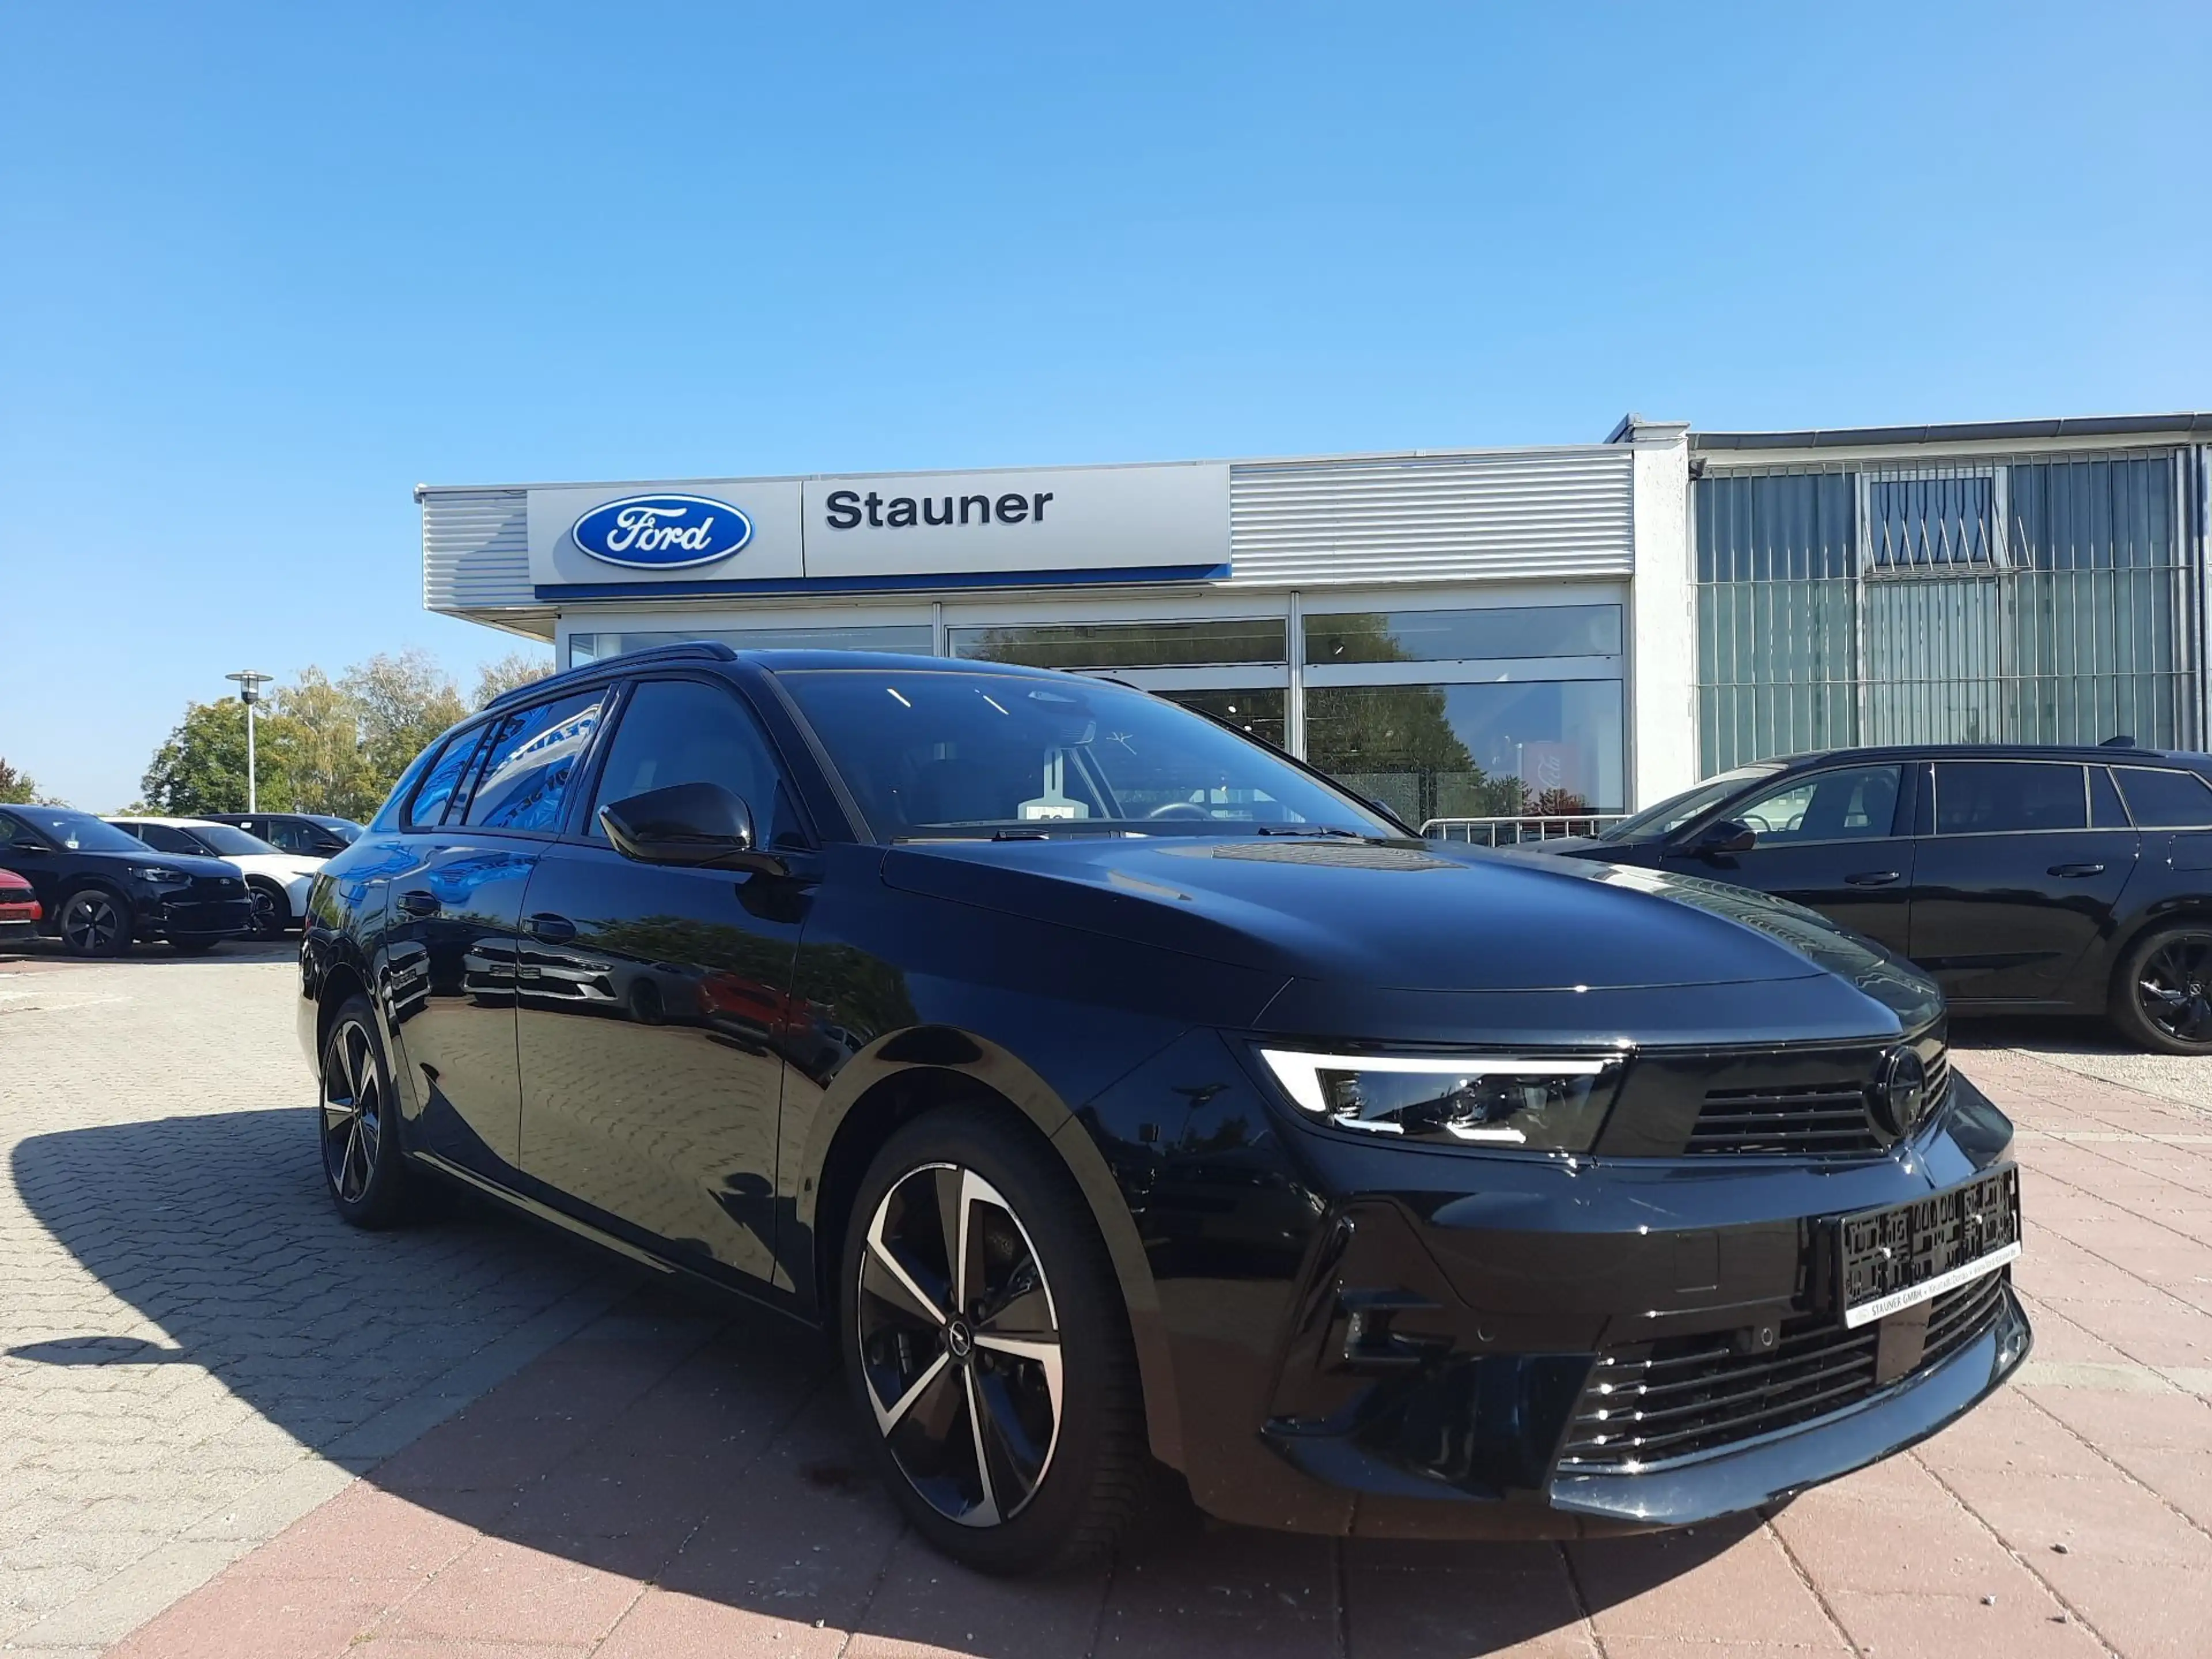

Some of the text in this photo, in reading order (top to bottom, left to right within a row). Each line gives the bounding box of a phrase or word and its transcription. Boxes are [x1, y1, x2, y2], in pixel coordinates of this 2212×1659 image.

[827, 490, 1054, 529] Stauner
[607, 507, 714, 552] Ford
[1872, 1296, 1902, 1316] STAUNER
